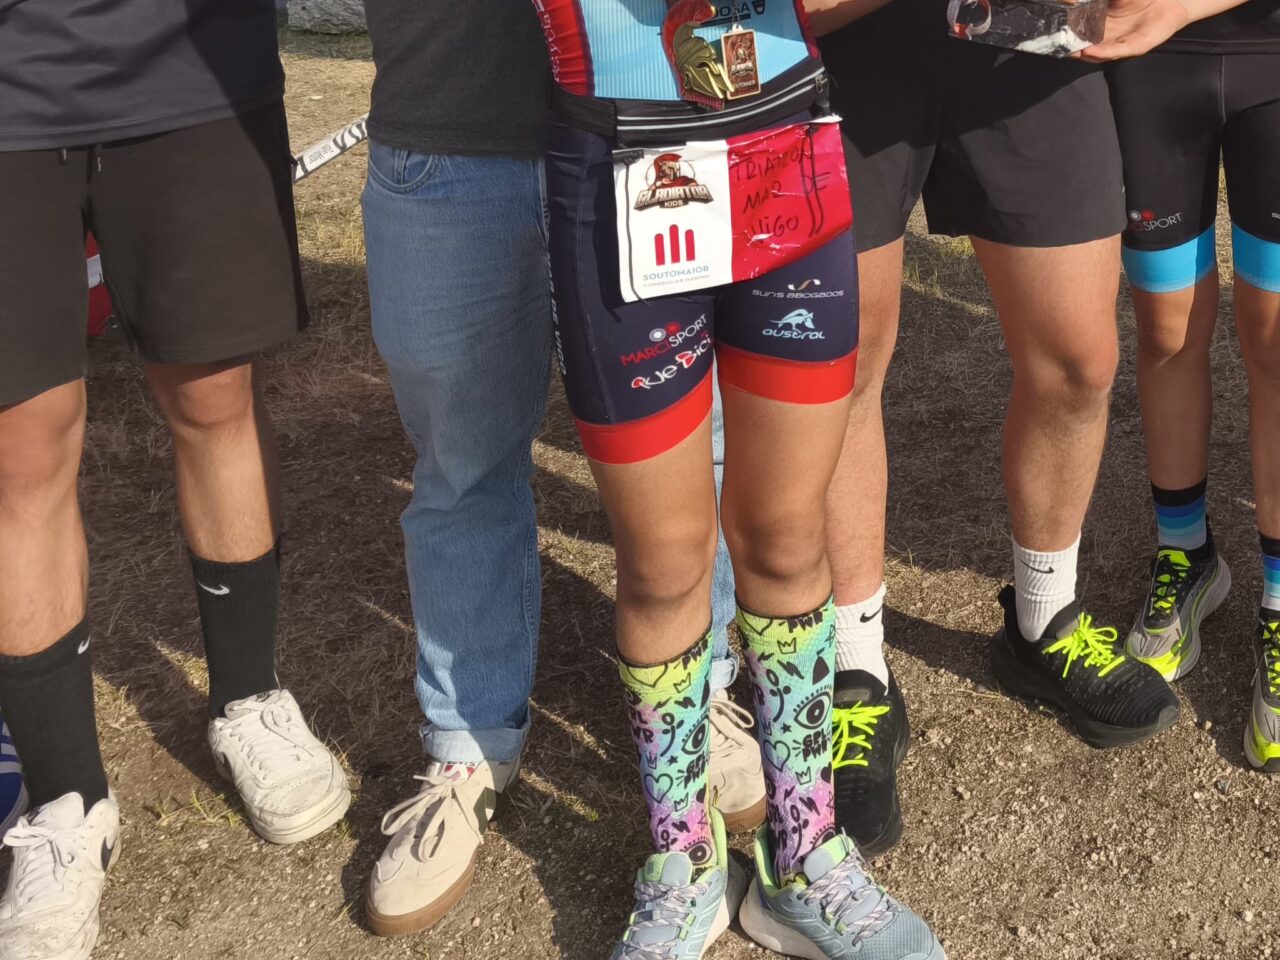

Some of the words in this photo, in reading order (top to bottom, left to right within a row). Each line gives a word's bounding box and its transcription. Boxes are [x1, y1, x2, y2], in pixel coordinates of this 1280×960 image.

[635, 185, 712, 208] GLADIATOR
[664, 199, 684, 208] KIDS
[643, 265, 710, 281] SOUTOMAIOR
[762, 328, 825, 339] austral
[787, 611, 824, 633] PWR
